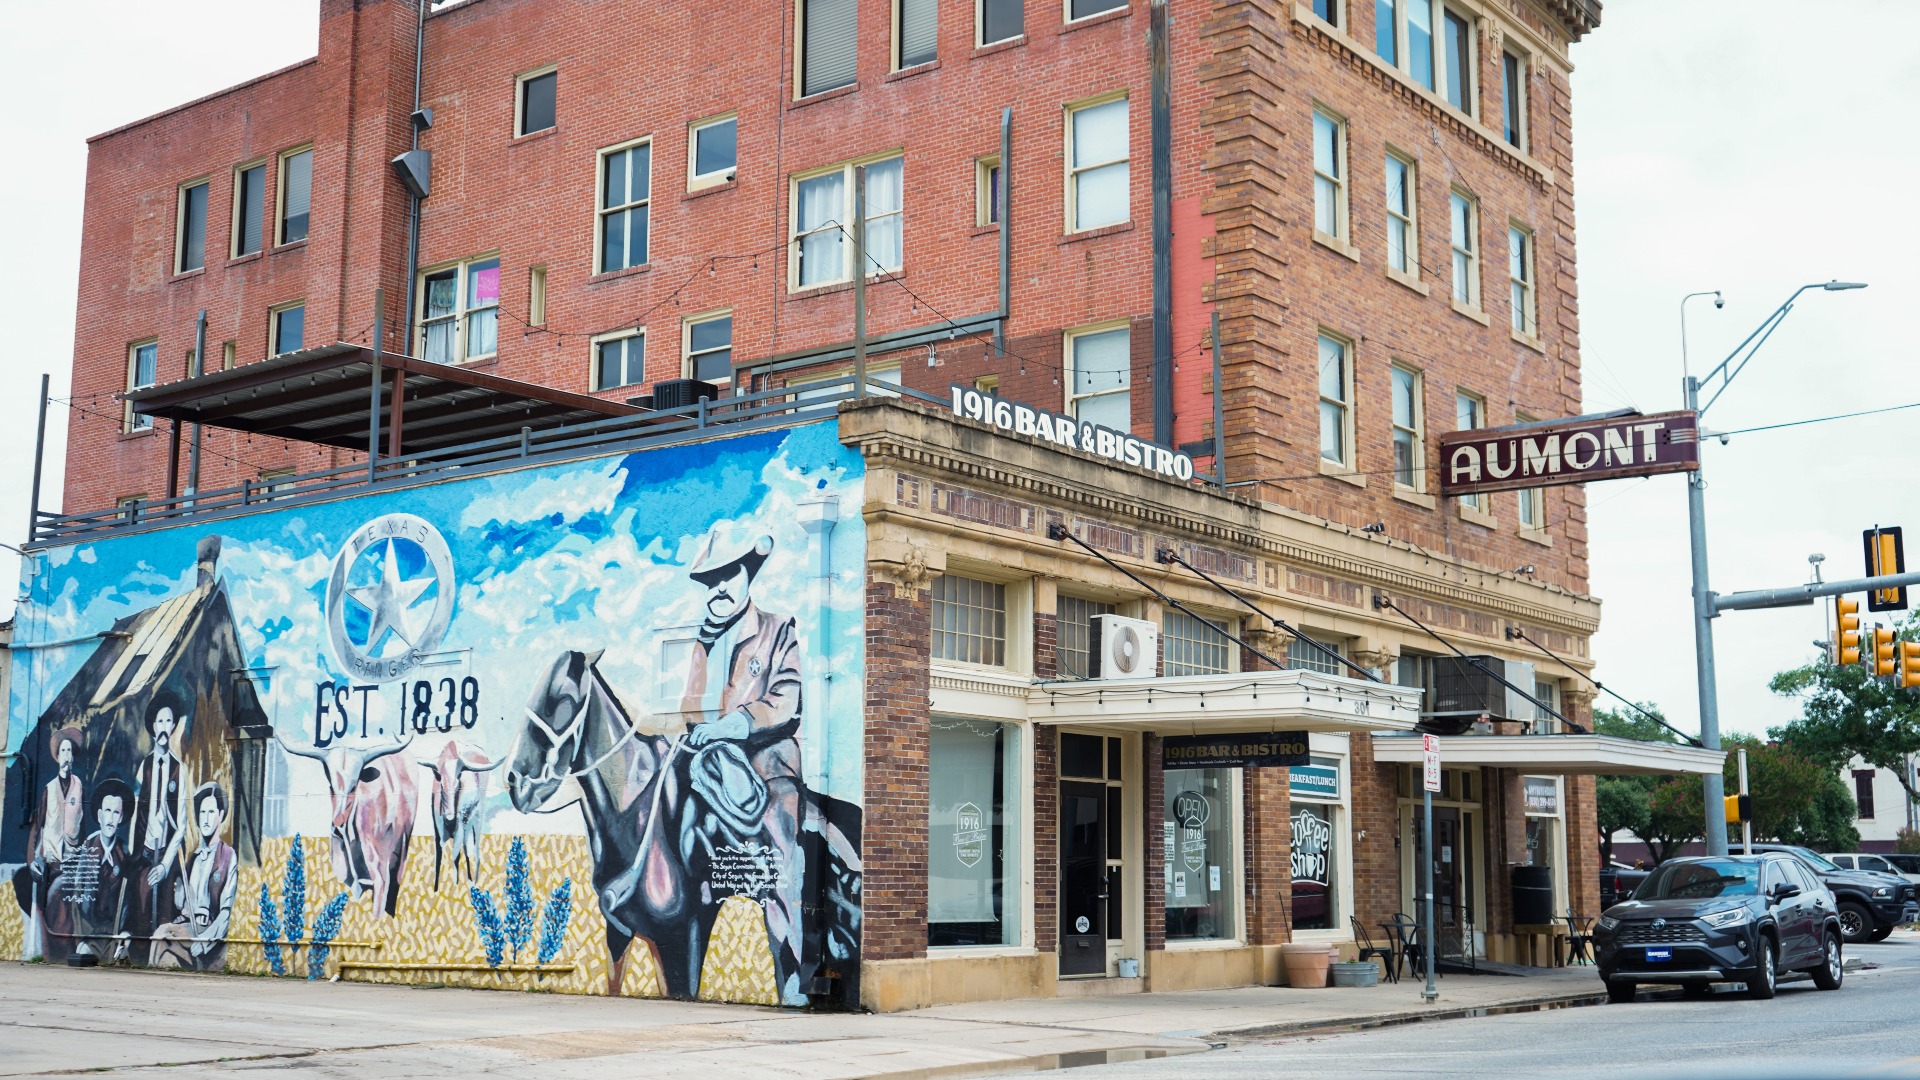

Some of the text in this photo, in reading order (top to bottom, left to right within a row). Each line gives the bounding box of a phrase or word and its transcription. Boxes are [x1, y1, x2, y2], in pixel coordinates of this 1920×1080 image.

[951, 386, 1193, 481] 1916 BAR & BISTRO
[1451, 422, 1665, 484] AUMONT
[350, 519, 429, 554] TEXAS
[354, 648, 423, 678] RANGER
[313, 676, 480, 748] EST. 1838
[1165, 742, 1306, 759] 1916 BAR & BISTRO
[1289, 773, 1336, 787] REAKFAST/LUNCH
[1177, 797, 1205, 821] OPEN
[961, 817, 979, 830] 1916
[1186, 828, 1201, 840] 1916
